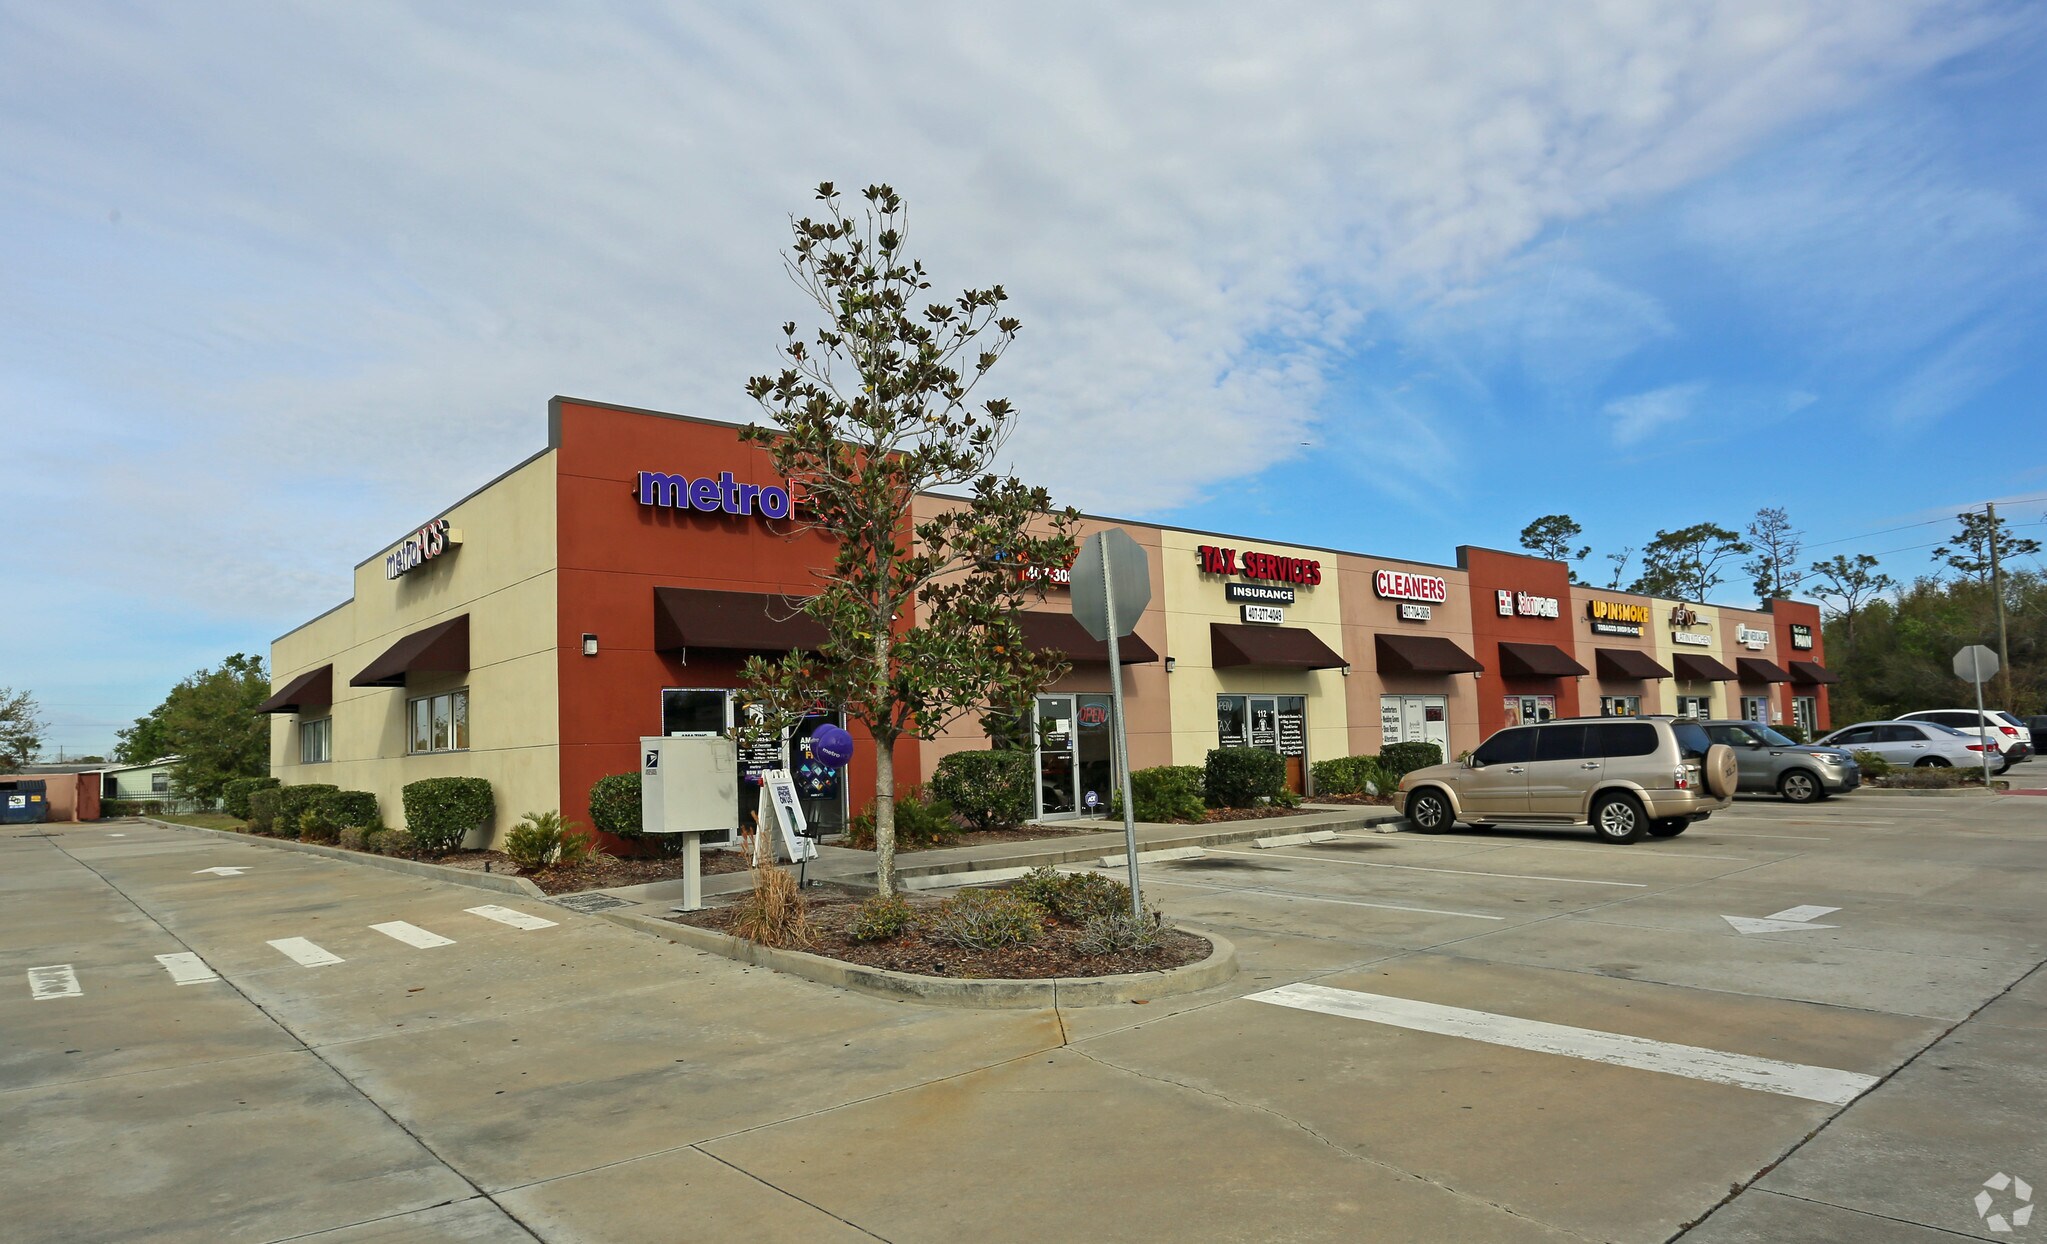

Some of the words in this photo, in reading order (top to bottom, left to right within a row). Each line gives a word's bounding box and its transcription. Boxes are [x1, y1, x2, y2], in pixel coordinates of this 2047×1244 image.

[386, 518, 443, 579] metroPCS
[1200, 545, 1238, 575] TAX
[1244, 551, 1321, 585] SERVICES
[1233, 587, 1294, 600] INSURANCE
[1378, 572, 1445, 600] CLEANERS
[1248, 607, 1282, 622] 407-277-4049
[1794, 634, 1811, 647] PAWN
[1079, 707, 1105, 723] OPEN
